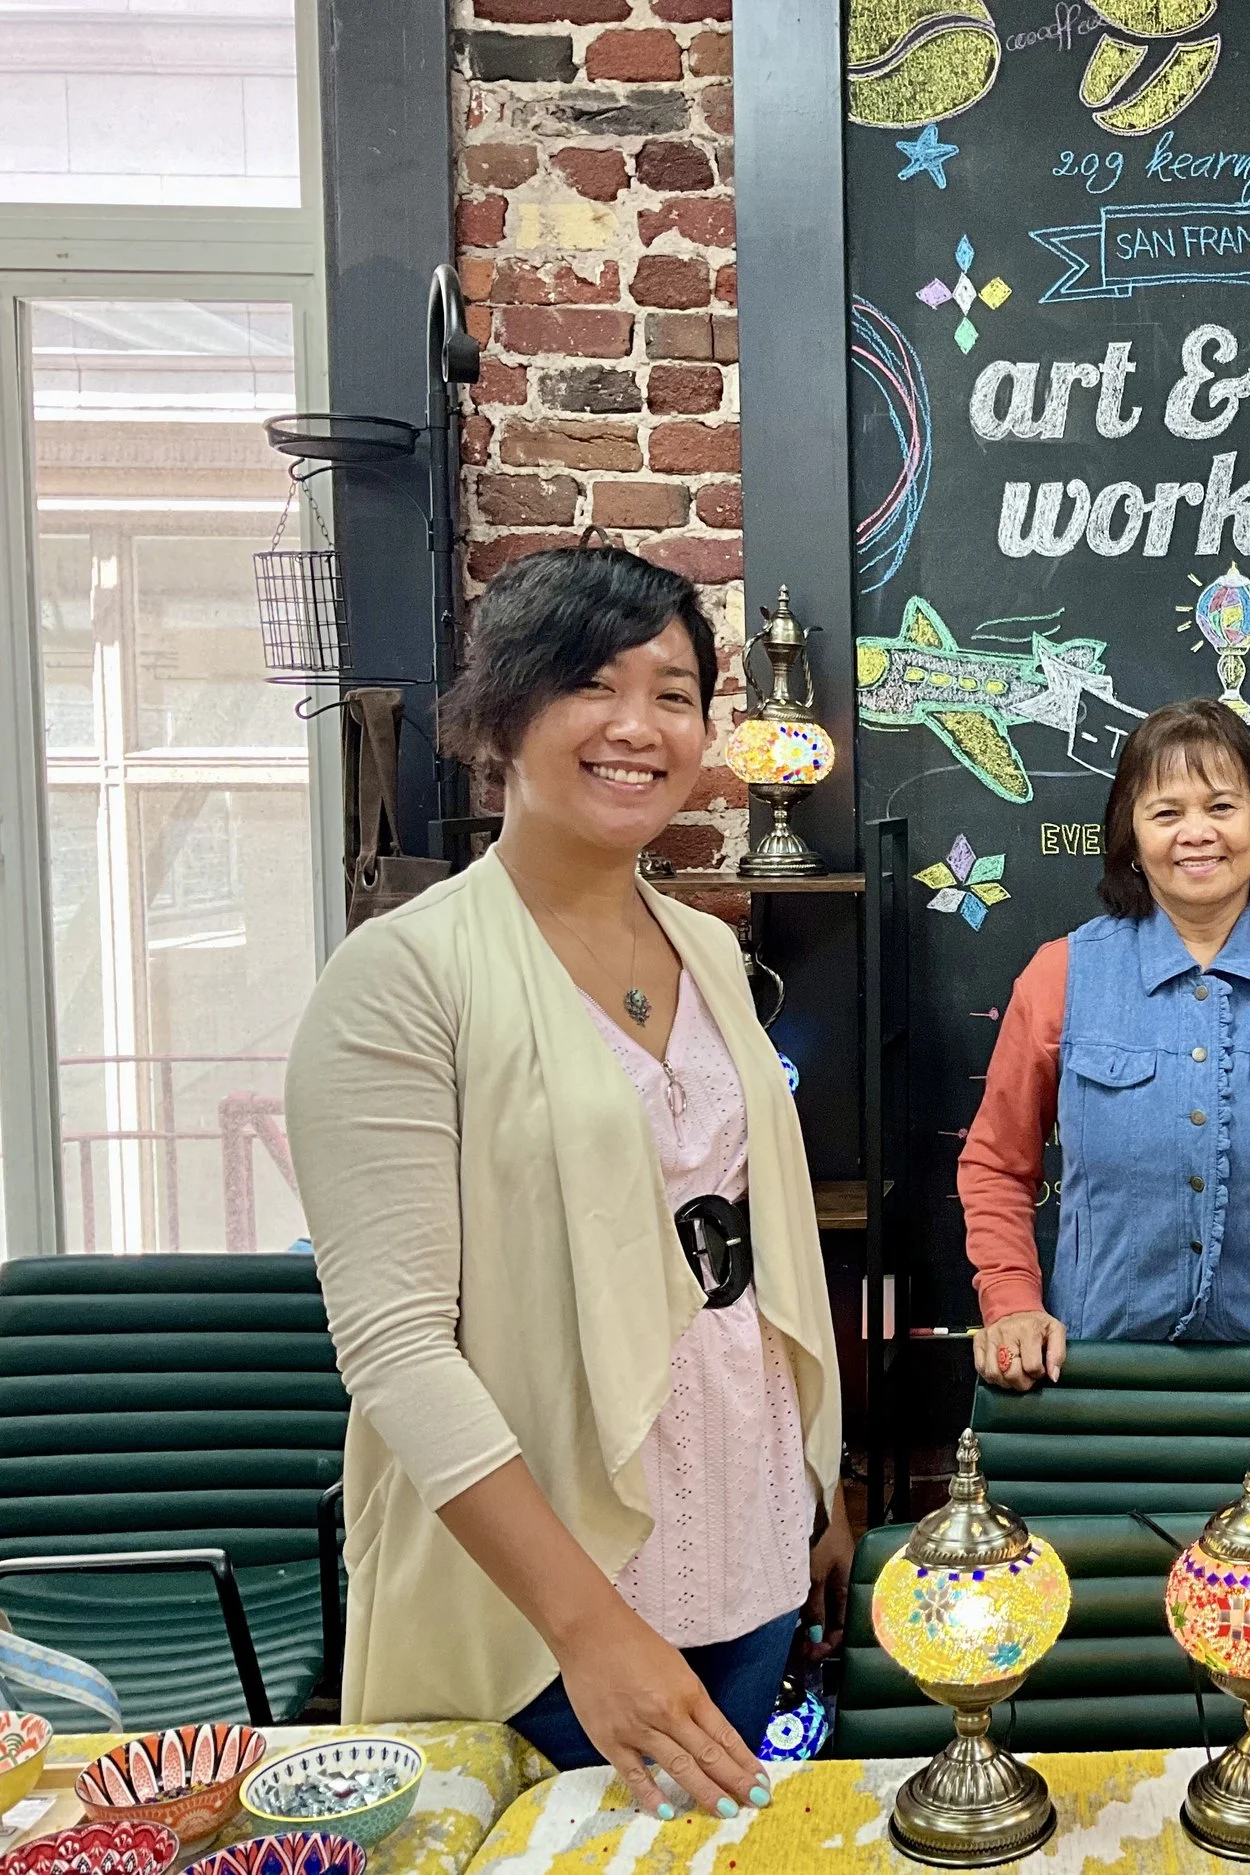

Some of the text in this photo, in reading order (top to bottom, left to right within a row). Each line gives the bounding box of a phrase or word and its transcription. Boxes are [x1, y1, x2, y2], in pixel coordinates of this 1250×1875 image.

[1052, 150, 1124, 194] 209
[1115, 227, 1177, 260] SAN
[969, 340, 1143, 441] art
[1041, 822, 1107, 856] EVE
